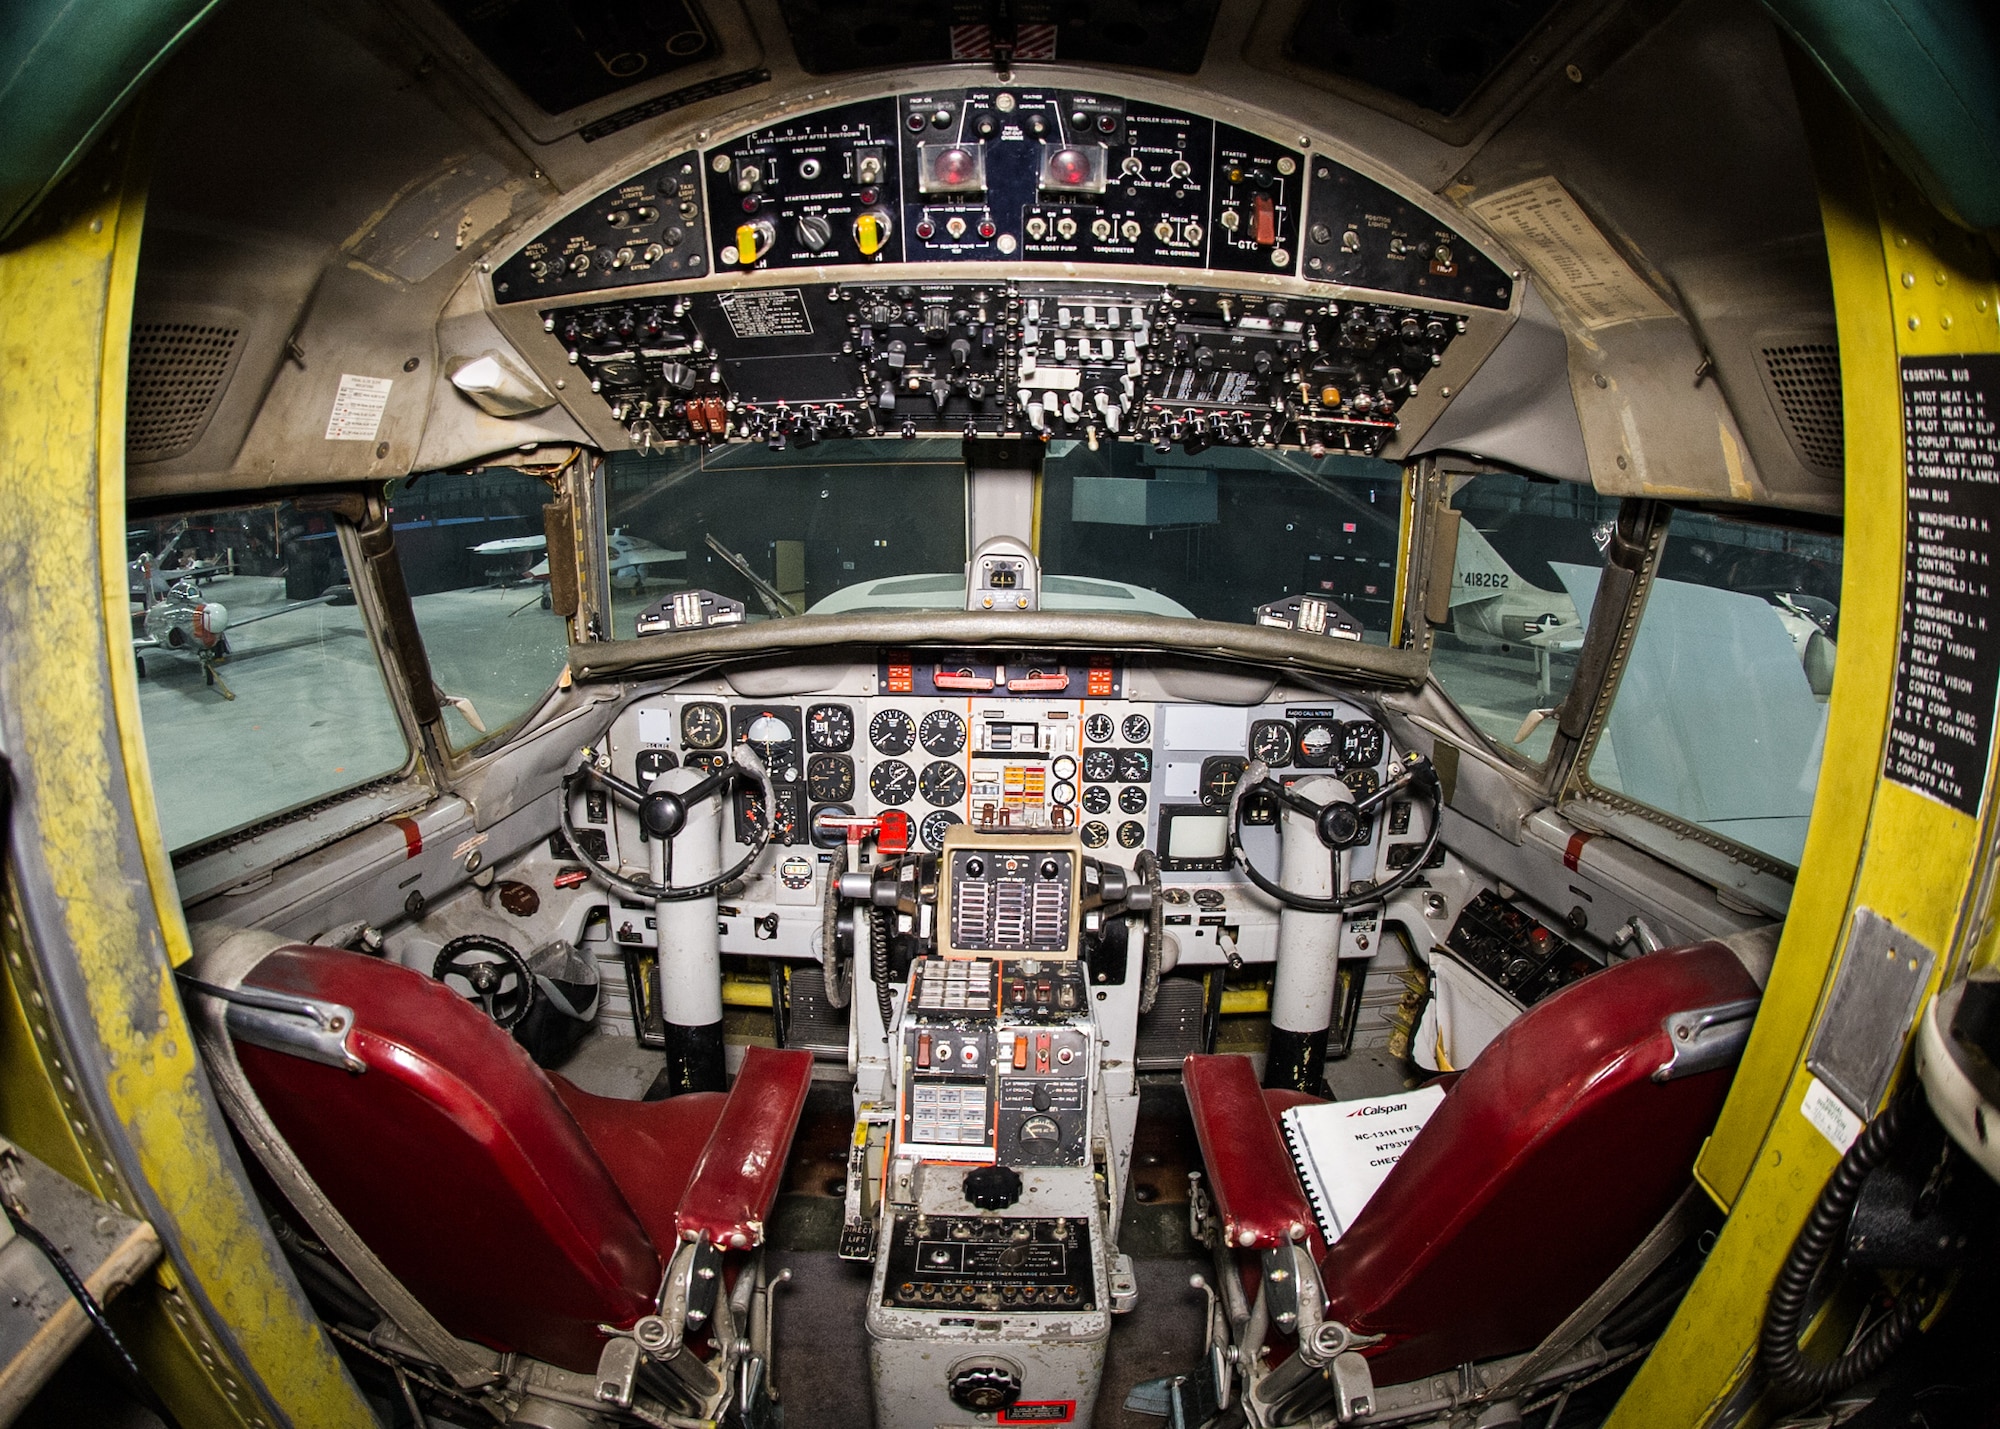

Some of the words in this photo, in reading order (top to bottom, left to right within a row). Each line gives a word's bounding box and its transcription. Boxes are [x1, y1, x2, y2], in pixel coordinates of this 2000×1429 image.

[1140, 147, 1174, 155] AUTOMATIC
[1254, 157, 1272, 165] READY
[619, 185, 645, 194] LANDING
[678, 189, 697, 197] LIGHT
[1237, 241, 1259, 251] GTC
[1902, 369, 1948, 381] ESSENTIAL
[1951, 369, 1970, 382] BUS
[1913, 391, 1937, 403] PITOT
[1940, 391, 1961, 403] HEAT
[1915, 406, 1938, 418] PITOT
[1941, 406, 1963, 419] HEAT
[1915, 421, 1939, 432] PILOT
[1943, 421, 1966, 434] TURN
[1976, 422, 1995, 435] SLIP
[1917, 436, 1950, 449] COPILOT
[1954, 437, 1977, 450] TURN
[1917, 450, 1940, 463] PILOT
[1971, 454, 1995, 468] GYRO
[1918, 466, 1958, 480] COMPASS
[1909, 488, 1929, 500] MAIN
[1932, 489, 1950, 503] BUS
[1918, 512, 1968, 530] WINDSHIELD
[1918, 526, 1945, 541] RELAY
[1918, 543, 1966, 562] WINDSHIELD
[1917, 557, 1956, 575] CONTROL
[1465, 572, 1509, 588] 418262
[1917, 573, 1966, 593] WINDSHIELD
[1916, 587, 1943, 603] RELAY
[1916, 603, 1965, 625] WINDSHIELD
[1914, 618, 1953, 639] CONTROL
[1913, 633, 1943, 651] DIRECT
[1947, 642, 1976, 661] VISION
[1911, 648, 1938, 666] RELAY
[1910, 664, 1941, 684] DIRECT
[1945, 675, 1973, 694] VISION
[1909, 680, 1948, 702] CONTROL
[1892, 728, 1916, 747] RADIO
[1919, 738, 1936, 754] BUS
[1937, 721, 1977, 747] CONTROL
[1899, 747, 1928, 768] PILOTS
[1897, 762, 1936, 787] COPILOTS
[1363, 1103, 1407, 1116] Calspan
[1355, 1129, 1398, 1141] NC-131H
[1399, 1125, 1421, 1134] TIFS
[845, 1226, 872, 1234] DIRECT
